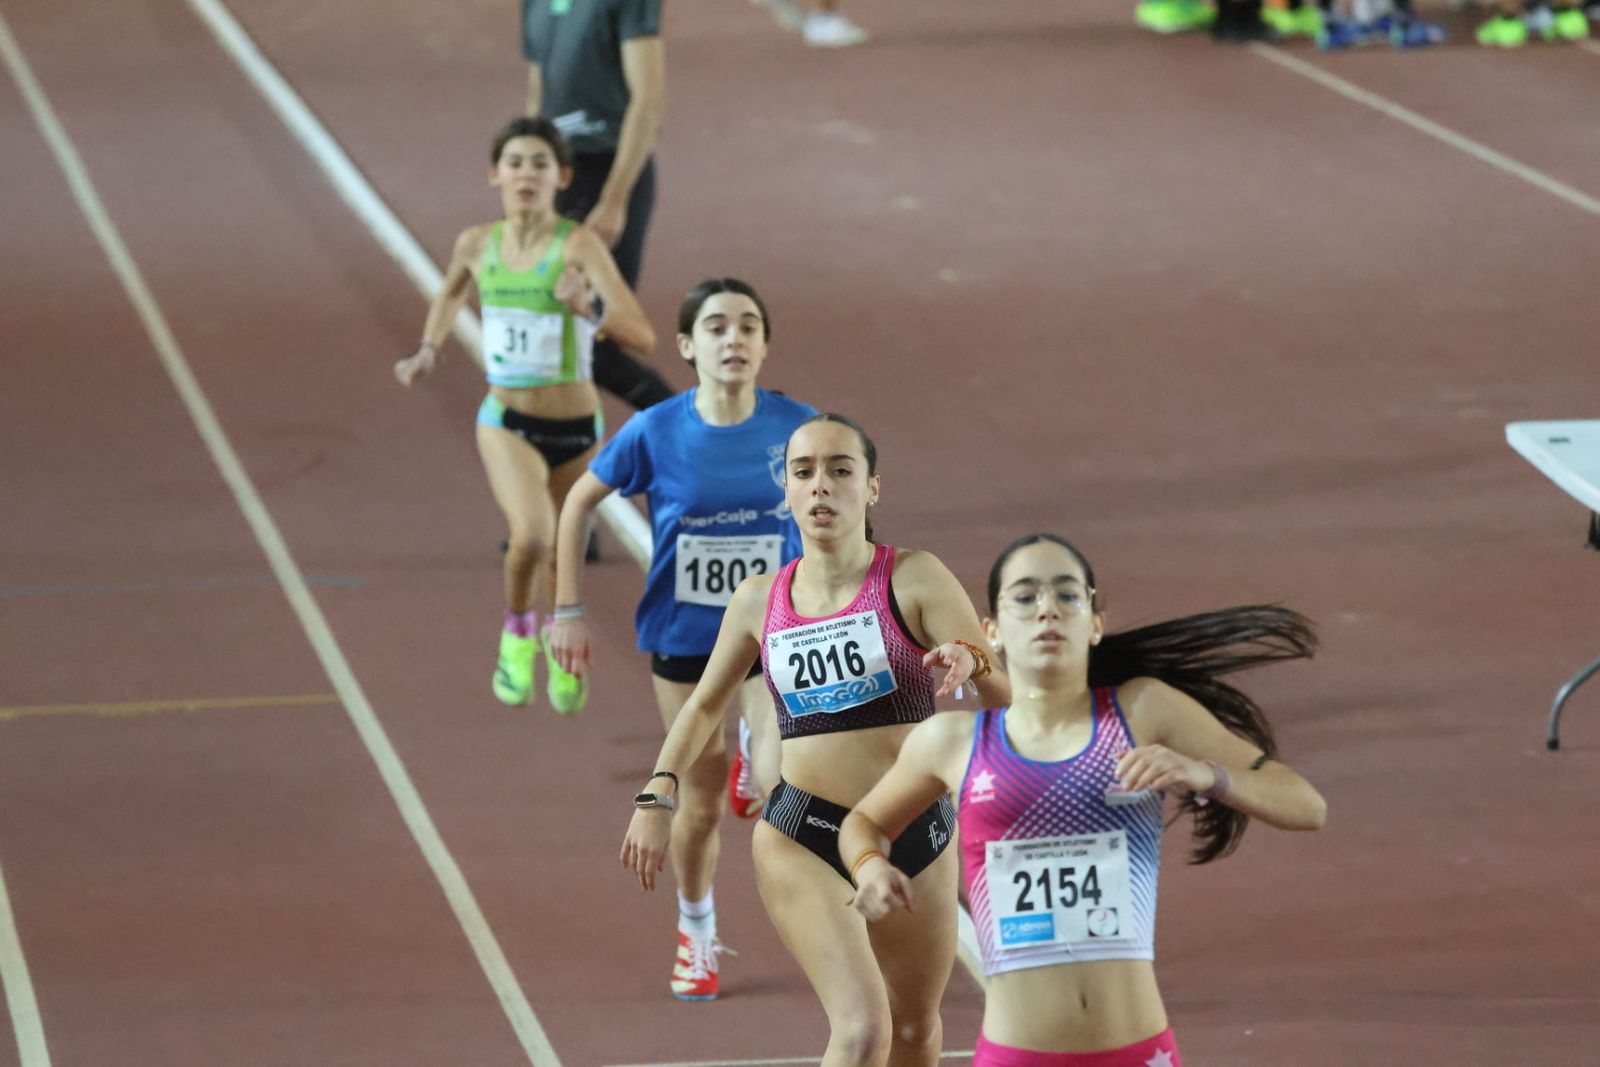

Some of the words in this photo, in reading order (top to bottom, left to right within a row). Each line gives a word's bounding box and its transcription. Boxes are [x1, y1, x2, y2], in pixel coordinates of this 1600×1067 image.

[505, 328, 527, 353] 31
[782, 628, 816, 640] FEDERACIÓN
[826, 619, 857, 631] ATLETISMO
[801, 636, 828, 646] CASTILLA
[833, 630, 849, 639] LEÓN
[788, 640, 865, 690] 2016
[1013, 865, 1102, 913] 2154
